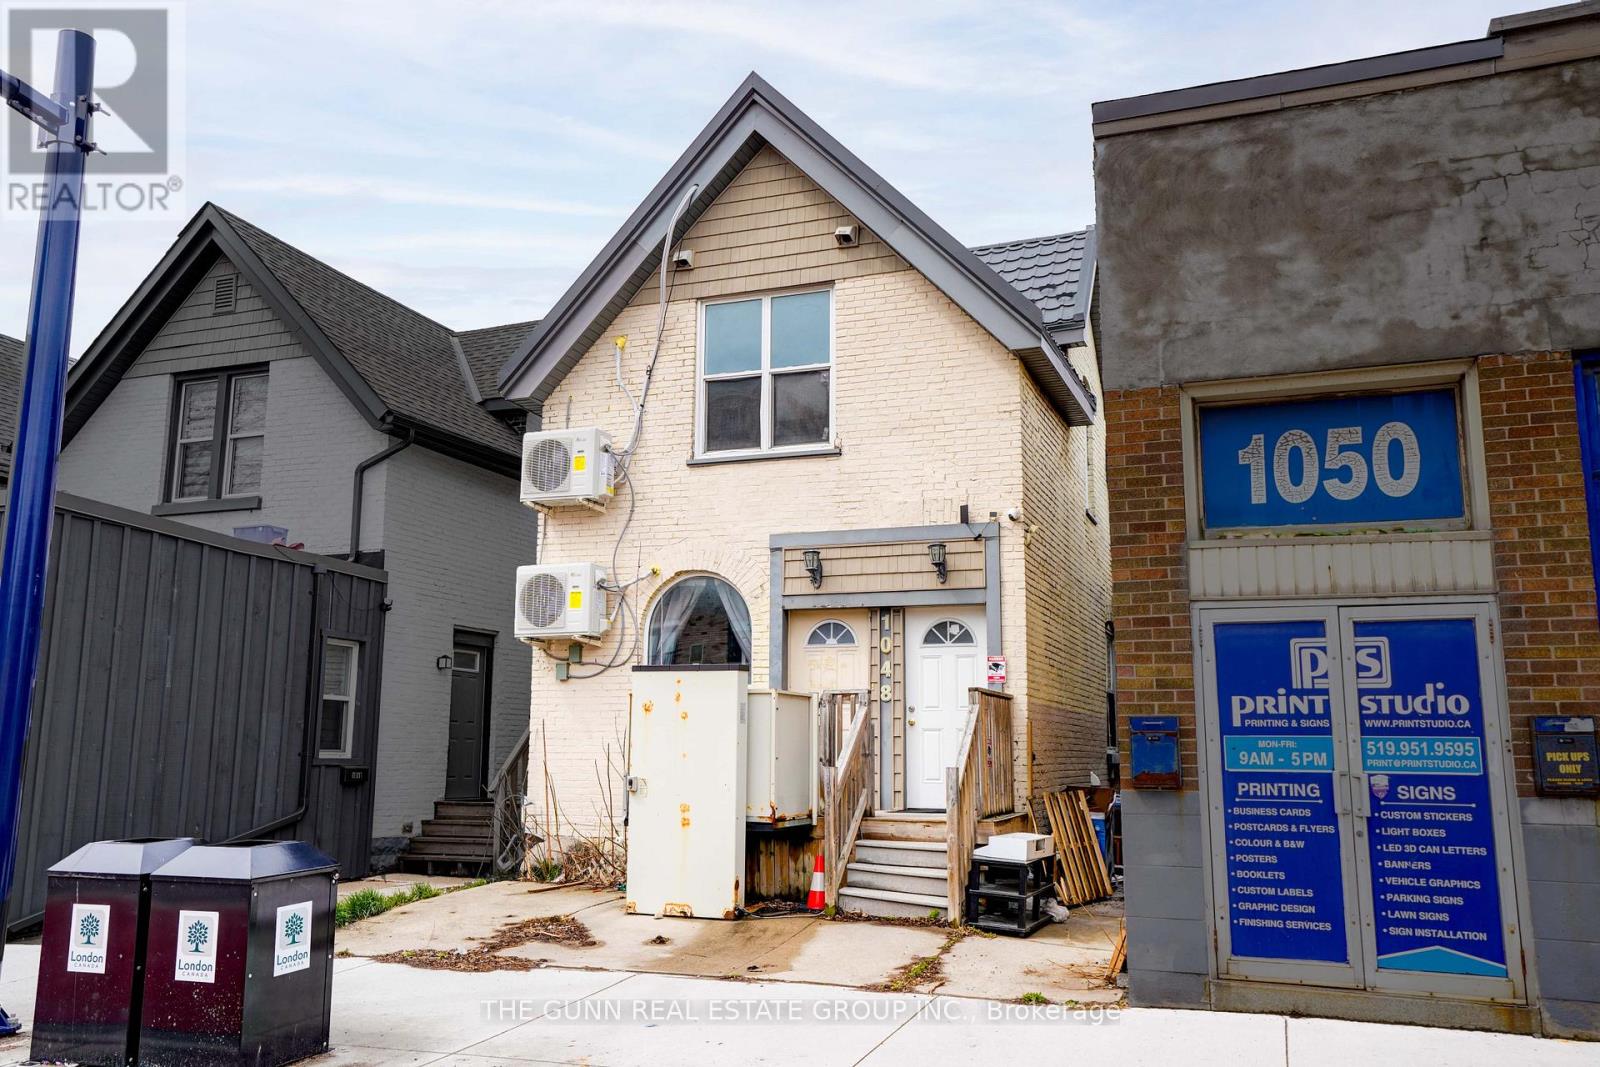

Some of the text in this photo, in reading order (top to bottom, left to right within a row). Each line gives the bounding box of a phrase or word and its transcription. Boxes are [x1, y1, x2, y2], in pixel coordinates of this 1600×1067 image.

[1238, 421, 1421, 505] 1050
[880, 614, 892, 703] 1048
[1245, 719, 1330, 728] PRINTING & SIGNS
[1364, 719, 1471, 729] WWW.PRINTSTUDIO.CA
[1258, 740, 1297, 749] MON-FRI:
[1367, 741, 1475, 757] 519.951.9595
[1239, 752, 1274, 766] 9AM
[1546, 752, 1590, 762] PICK UPS
[1367, 758, 1477, 770] PRINT@PRINTSTUDIO.CA
[1559, 764, 1582, 774] ONLY
[1238, 782, 1320, 798] PRINTING
[1397, 785, 1456, 801] SIGNS
[1233, 807, 1312, 817] BUSINESS CARDS
[1380, 811, 1473, 822] CUSTOM STICKERS
[1234, 824, 1289, 833] POSTCARDS
[1300, 825, 1336, 834] FLYERS
[1381, 828, 1446, 838] LIGHT BOXES
[1235, 839, 1305, 849] COLOUR & B&W
[1383, 844, 1487, 856] LED 3D CAN LETTERS
[1235, 855, 1278, 864] POSTERS
[1384, 860, 1432, 870] BANNERS
[1236, 870, 1286, 880] BOOKLETS
[1385, 877, 1481, 889] VEHICLE GRAPHICS
[1237, 886, 1314, 897] CUSTOM LABELS
[1386, 893, 1464, 905] PARKING SIGNS
[1238, 903, 1316, 914] GRAPHIC DESIGN
[1387, 910, 1450, 922] LAWN SIGNS
[1239, 918, 1332, 931] FINISHING SERVICES
[1389, 927, 1487, 941] SIGN INSTALLATION
[71, 951, 104, 963] London
[276, 950, 309, 966] London
[178, 959, 213, 971] London
